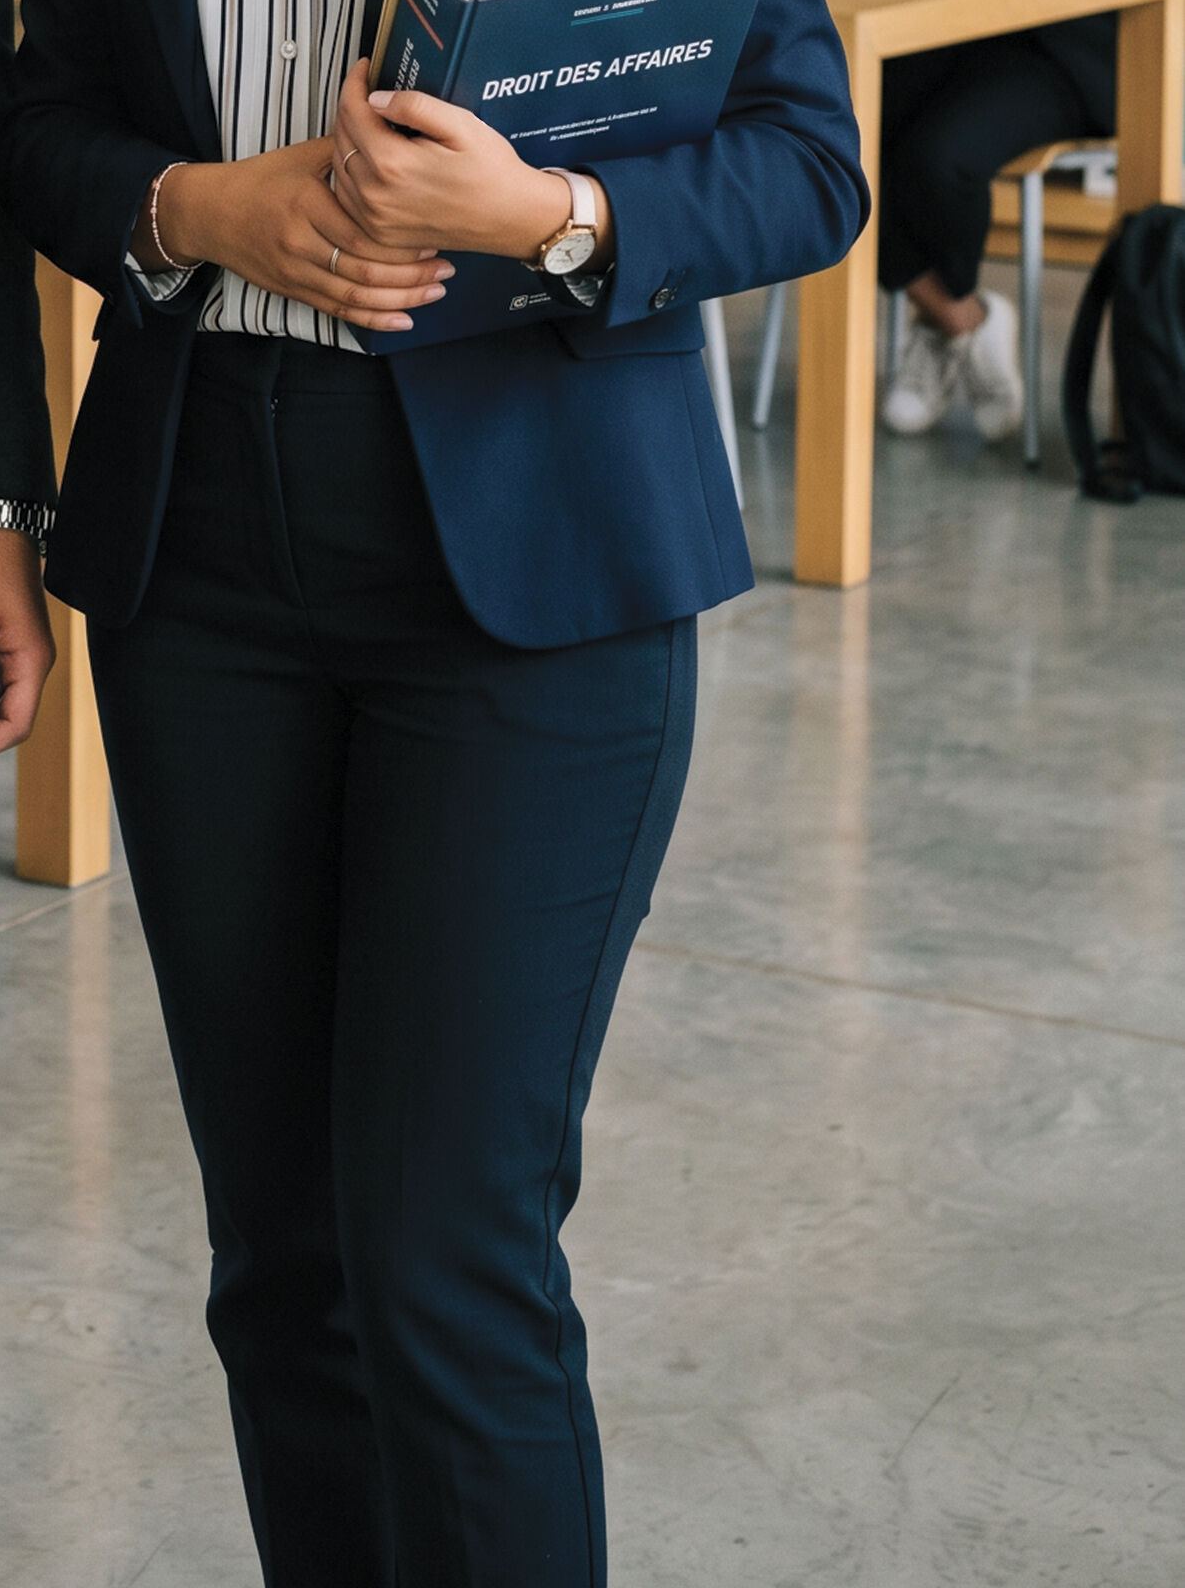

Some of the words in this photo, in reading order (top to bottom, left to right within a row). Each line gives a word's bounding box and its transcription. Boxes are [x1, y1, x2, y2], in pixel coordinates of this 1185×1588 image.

[482, 69, 553, 100] DROIT
[555, 61, 602, 87] DES
[604, 39, 713, 78] AFFAIRES
